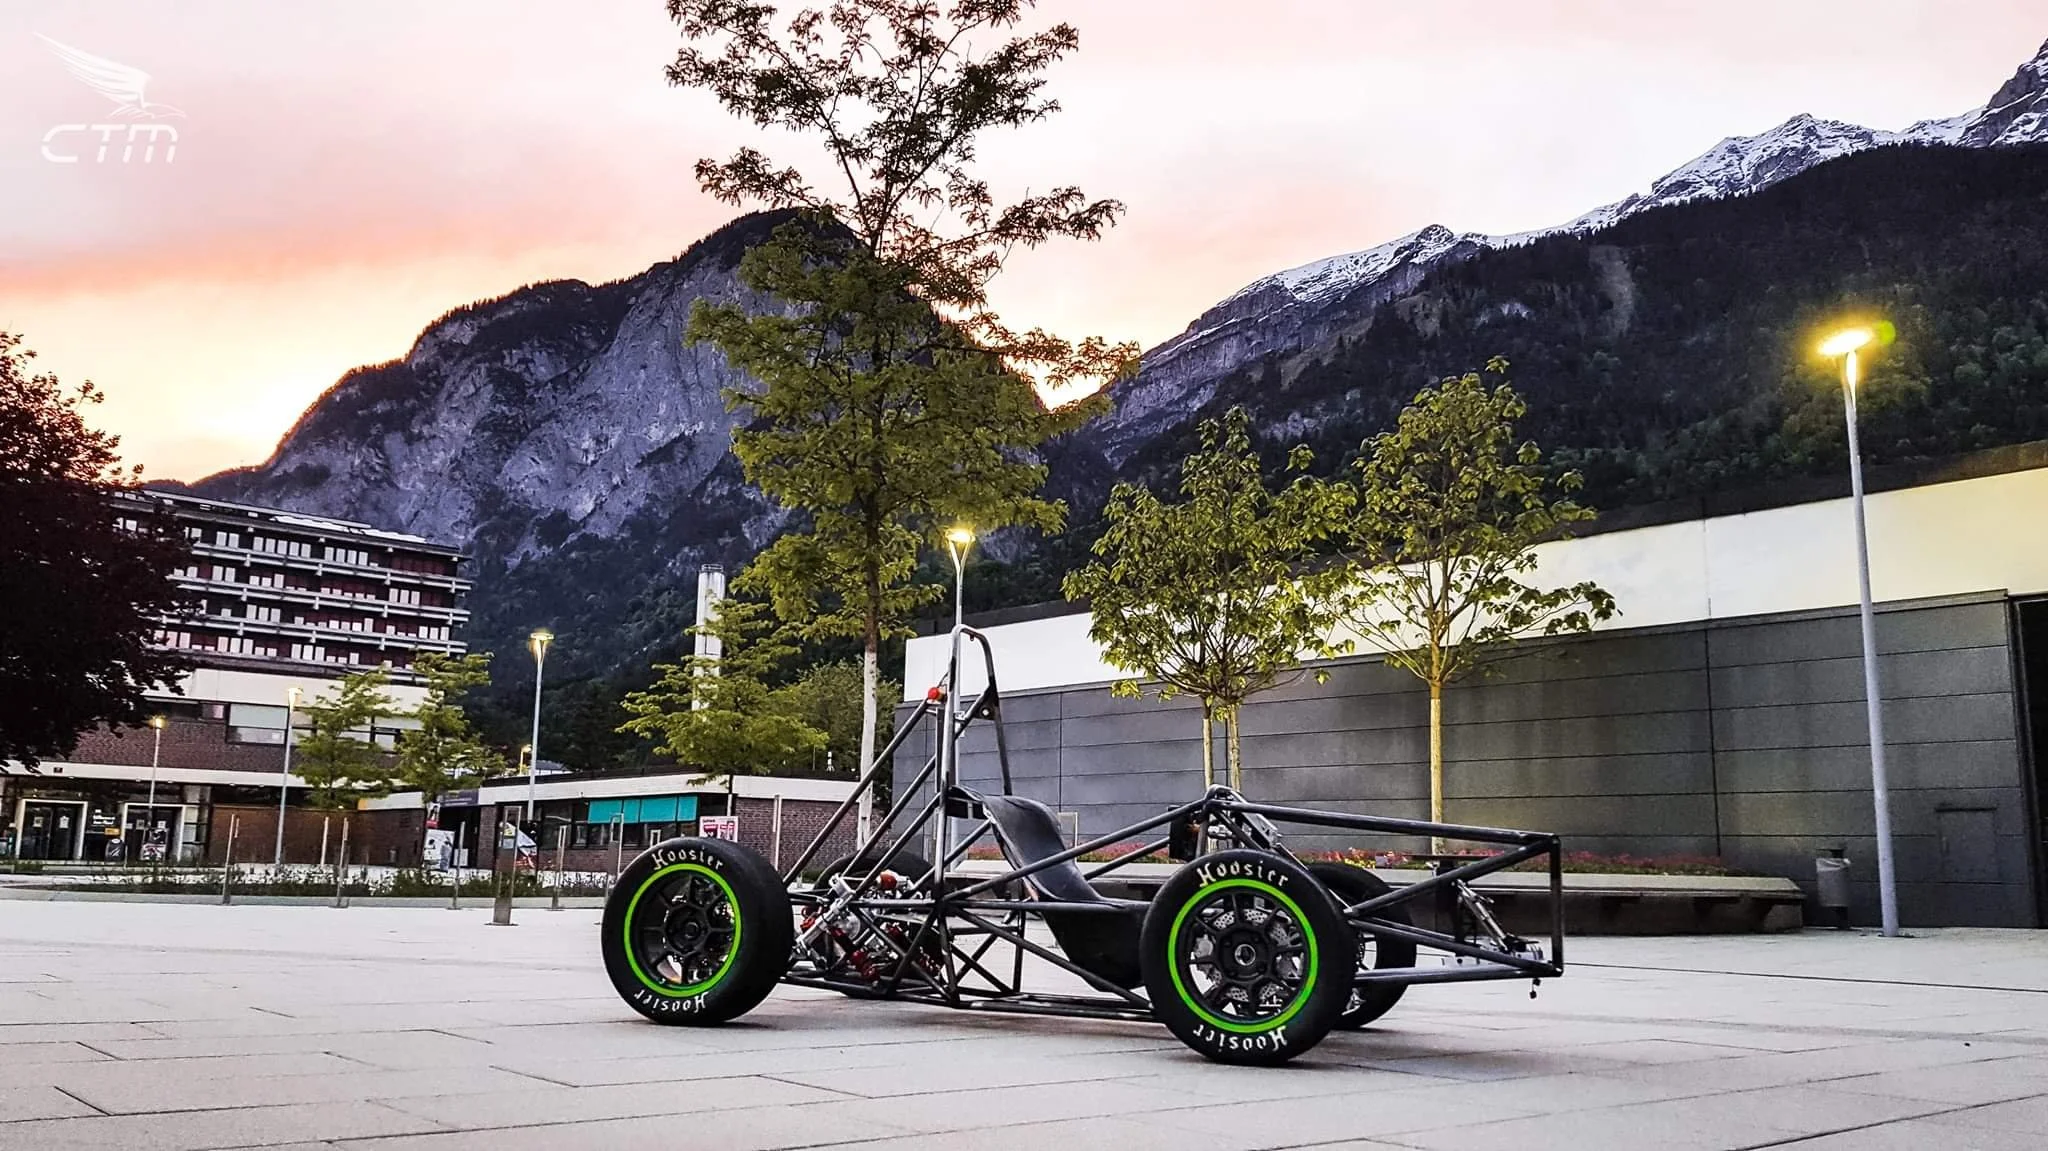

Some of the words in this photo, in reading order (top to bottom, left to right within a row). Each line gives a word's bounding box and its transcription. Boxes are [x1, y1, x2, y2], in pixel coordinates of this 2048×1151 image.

[651, 846, 724, 870] Hoosier
[1196, 860, 1289, 887] Hoosier
[634, 989, 709, 1013] Hoosier
[1192, 1024, 1288, 1052] Hoosier
